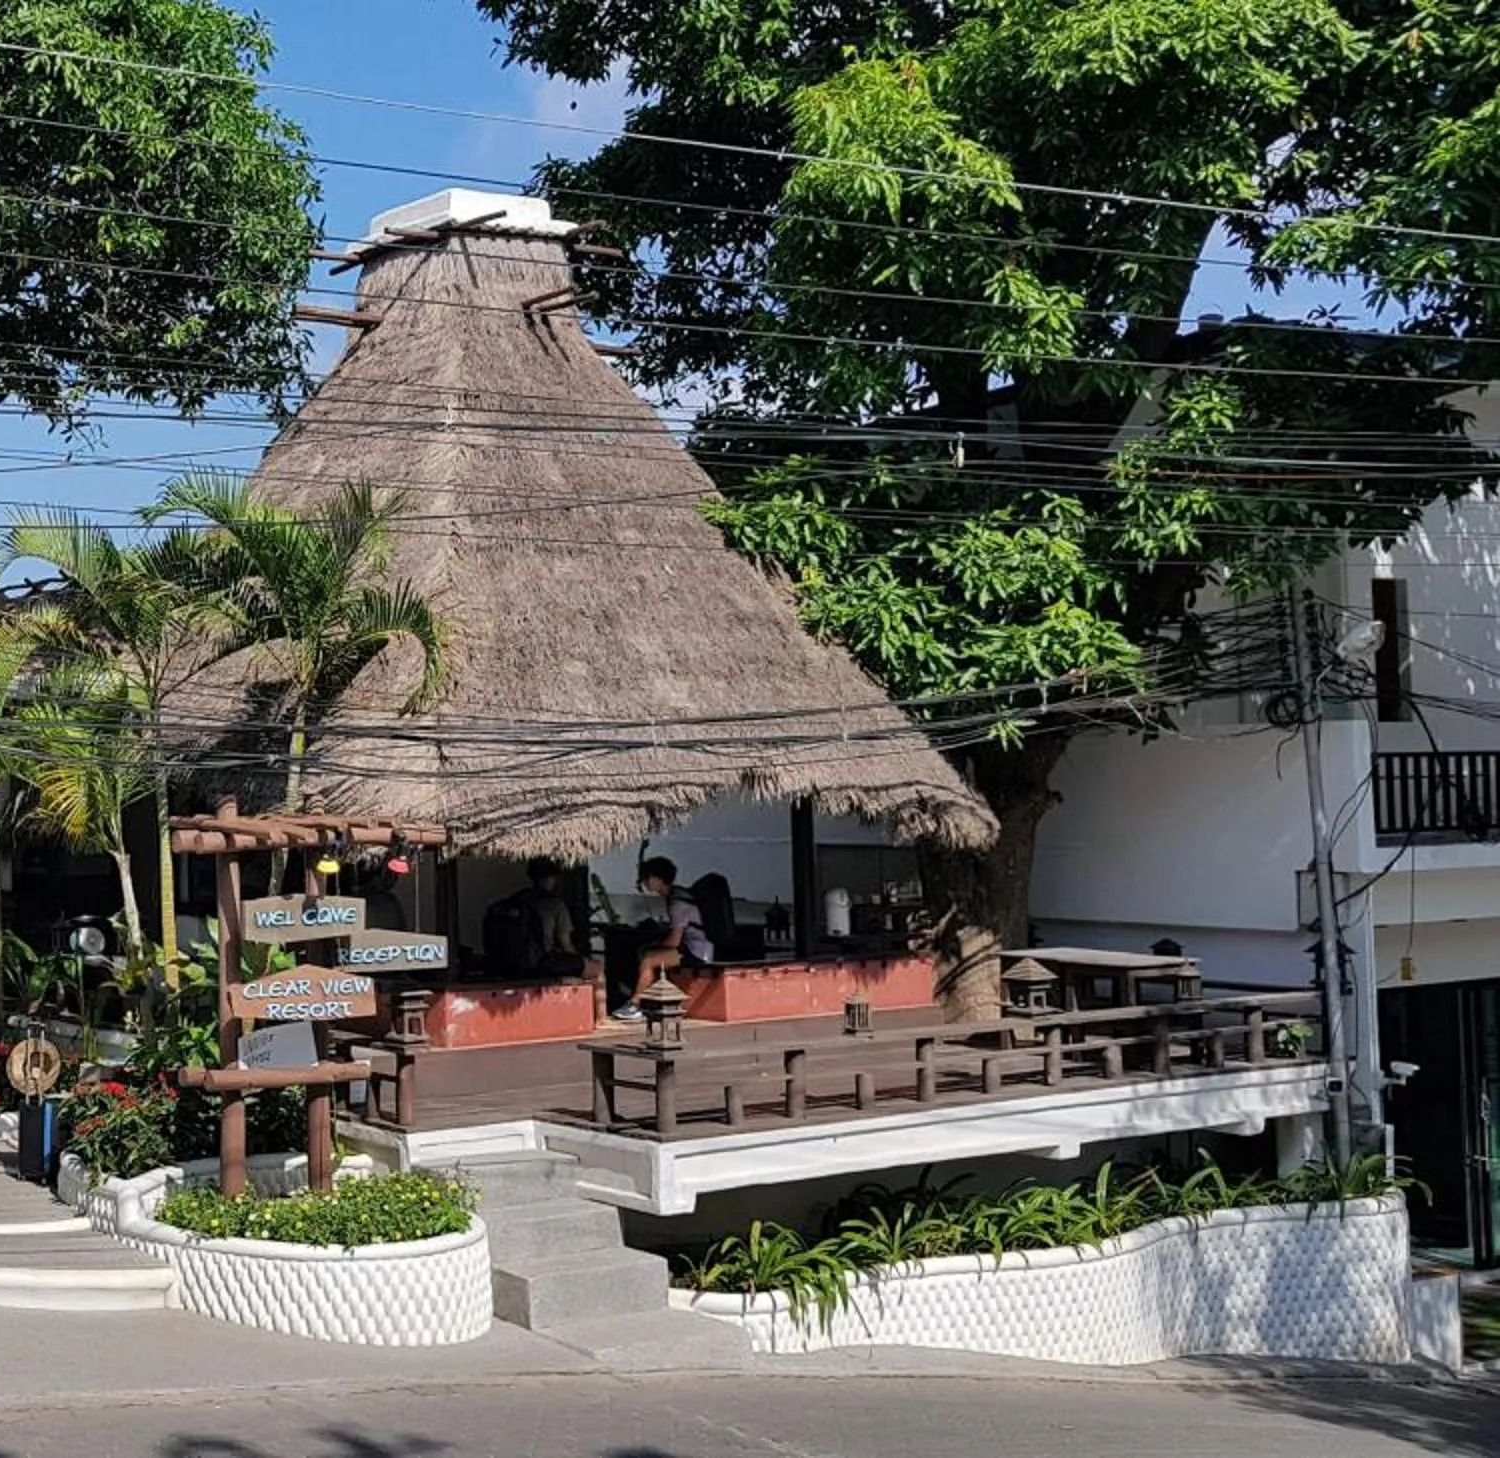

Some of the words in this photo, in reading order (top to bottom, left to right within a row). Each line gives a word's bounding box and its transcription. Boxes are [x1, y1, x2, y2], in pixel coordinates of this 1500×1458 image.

[337, 944, 445, 964] RECEPTION
[243, 979, 312, 999] CLEAR
[321, 977, 372, 996] VIEW
[267, 1001, 353, 1020] RESORT
